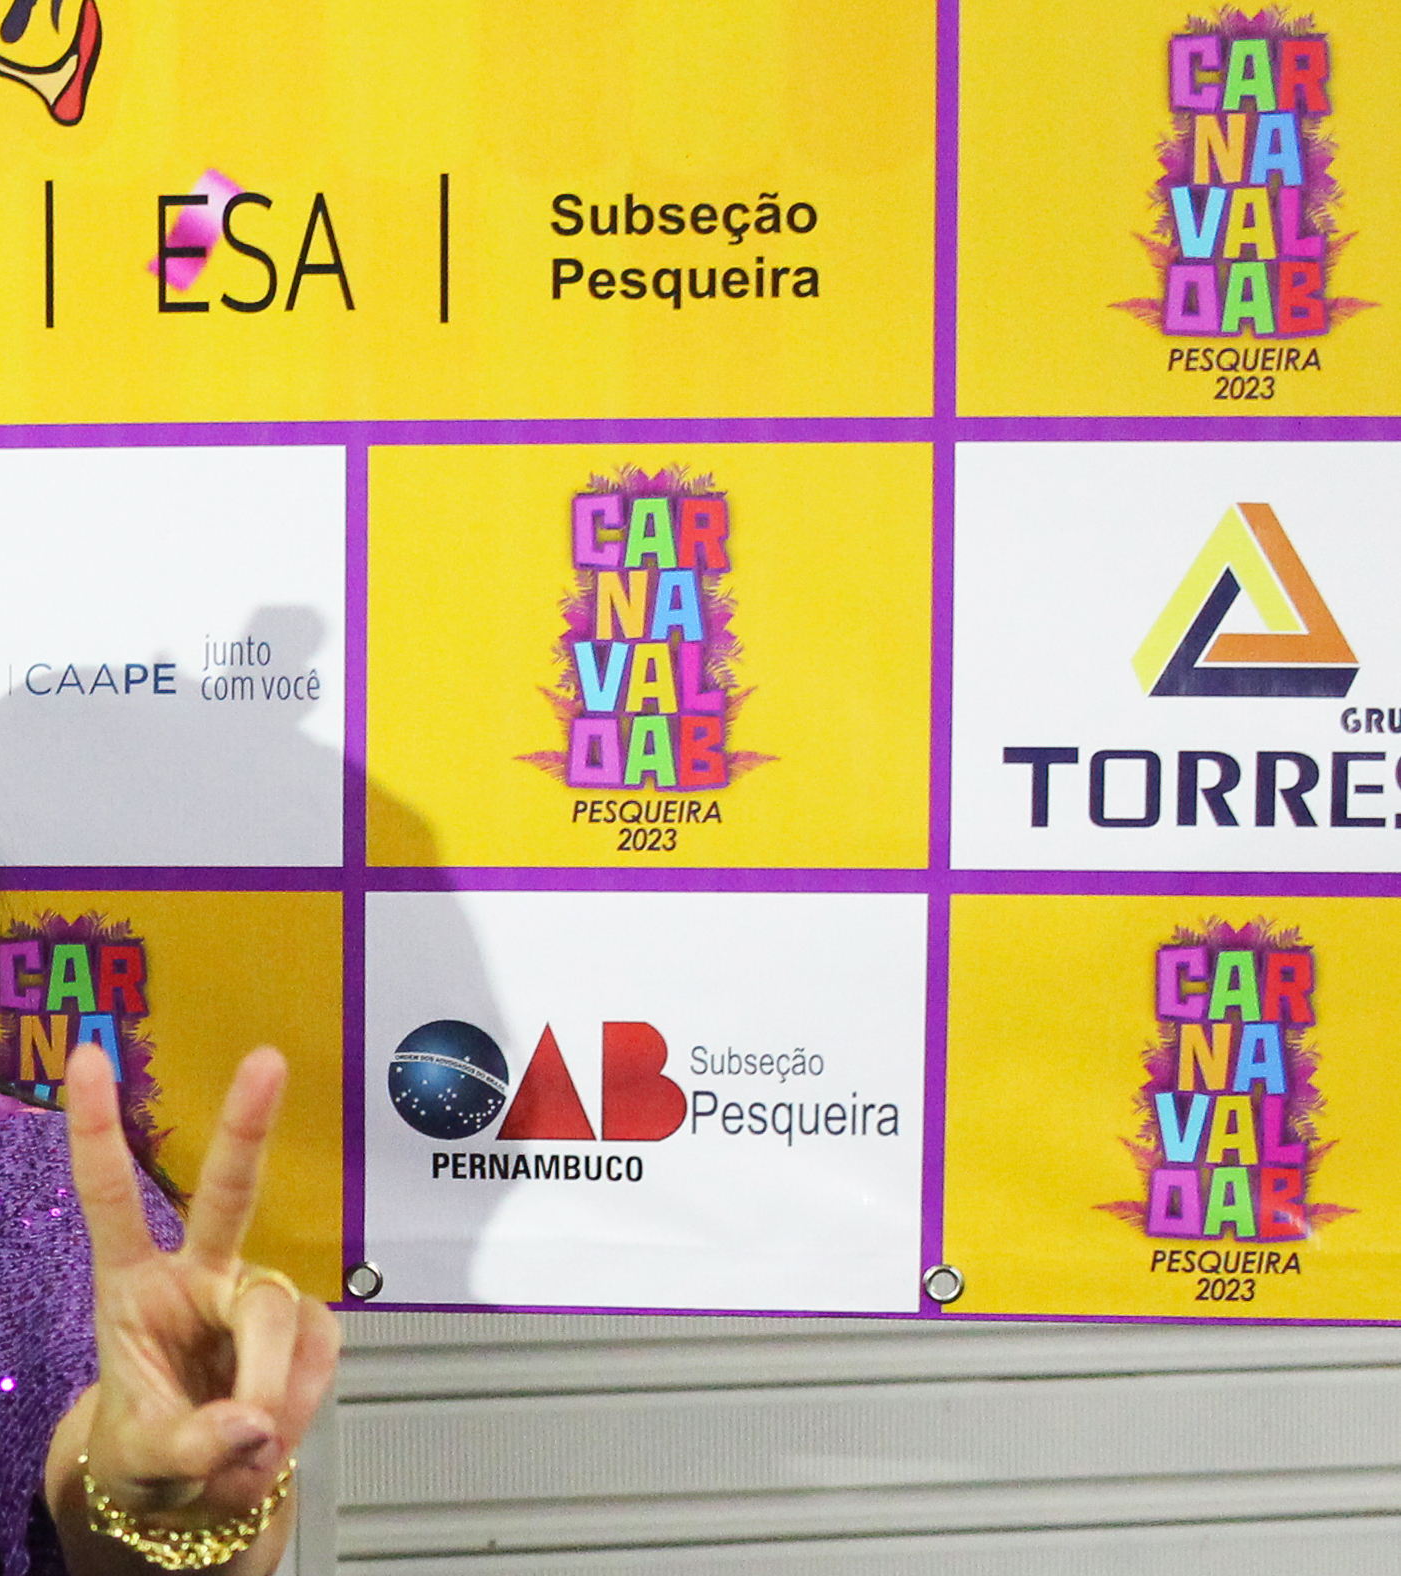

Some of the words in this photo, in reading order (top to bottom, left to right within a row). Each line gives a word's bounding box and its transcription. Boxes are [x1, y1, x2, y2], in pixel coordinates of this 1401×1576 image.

[1170, 35, 1331, 112] CAR
[1192, 112, 1304, 186] NA
[550, 191, 819, 245] Subseção
[1170, 186, 1327, 260] VAL
[156, 192, 356, 313] ESA
[551, 255, 821, 310] Pesqueira
[1164, 260, 1328, 335] OAB
[1167, 347, 1322, 372] PESQUEIRA
[1214, 375, 1276, 400] 2023
[572, 495, 730, 569] CAR
[595, 569, 705, 642] NA
[24, 662, 177, 696] CAAPE
[201, 633, 272, 671] junto
[573, 641, 726, 714] VAL
[200, 675, 255, 702] com
[262, 667, 321, 702] você
[568, 714, 729, 788] OAB
[571, 799, 723, 824] PESQUEIRA
[1002, 746, 1401, 829] TORRE
[616, 827, 678, 852] 2023
[1156, 946, 1315, 1024] CAR
[689, 1044, 825, 1085] Subseção
[1177, 1022, 1287, 1094] NA
[690, 1090, 900, 1147] Pesqueira
[1155, 1091, 1309, 1165] VAL
[431, 1151, 644, 1183] PERNAMBUCO
[1147, 1165, 1309, 1240] OAB
[1150, 1248, 1302, 1275] PESQUEIRA
[1195, 1277, 1256, 1302] 2023
